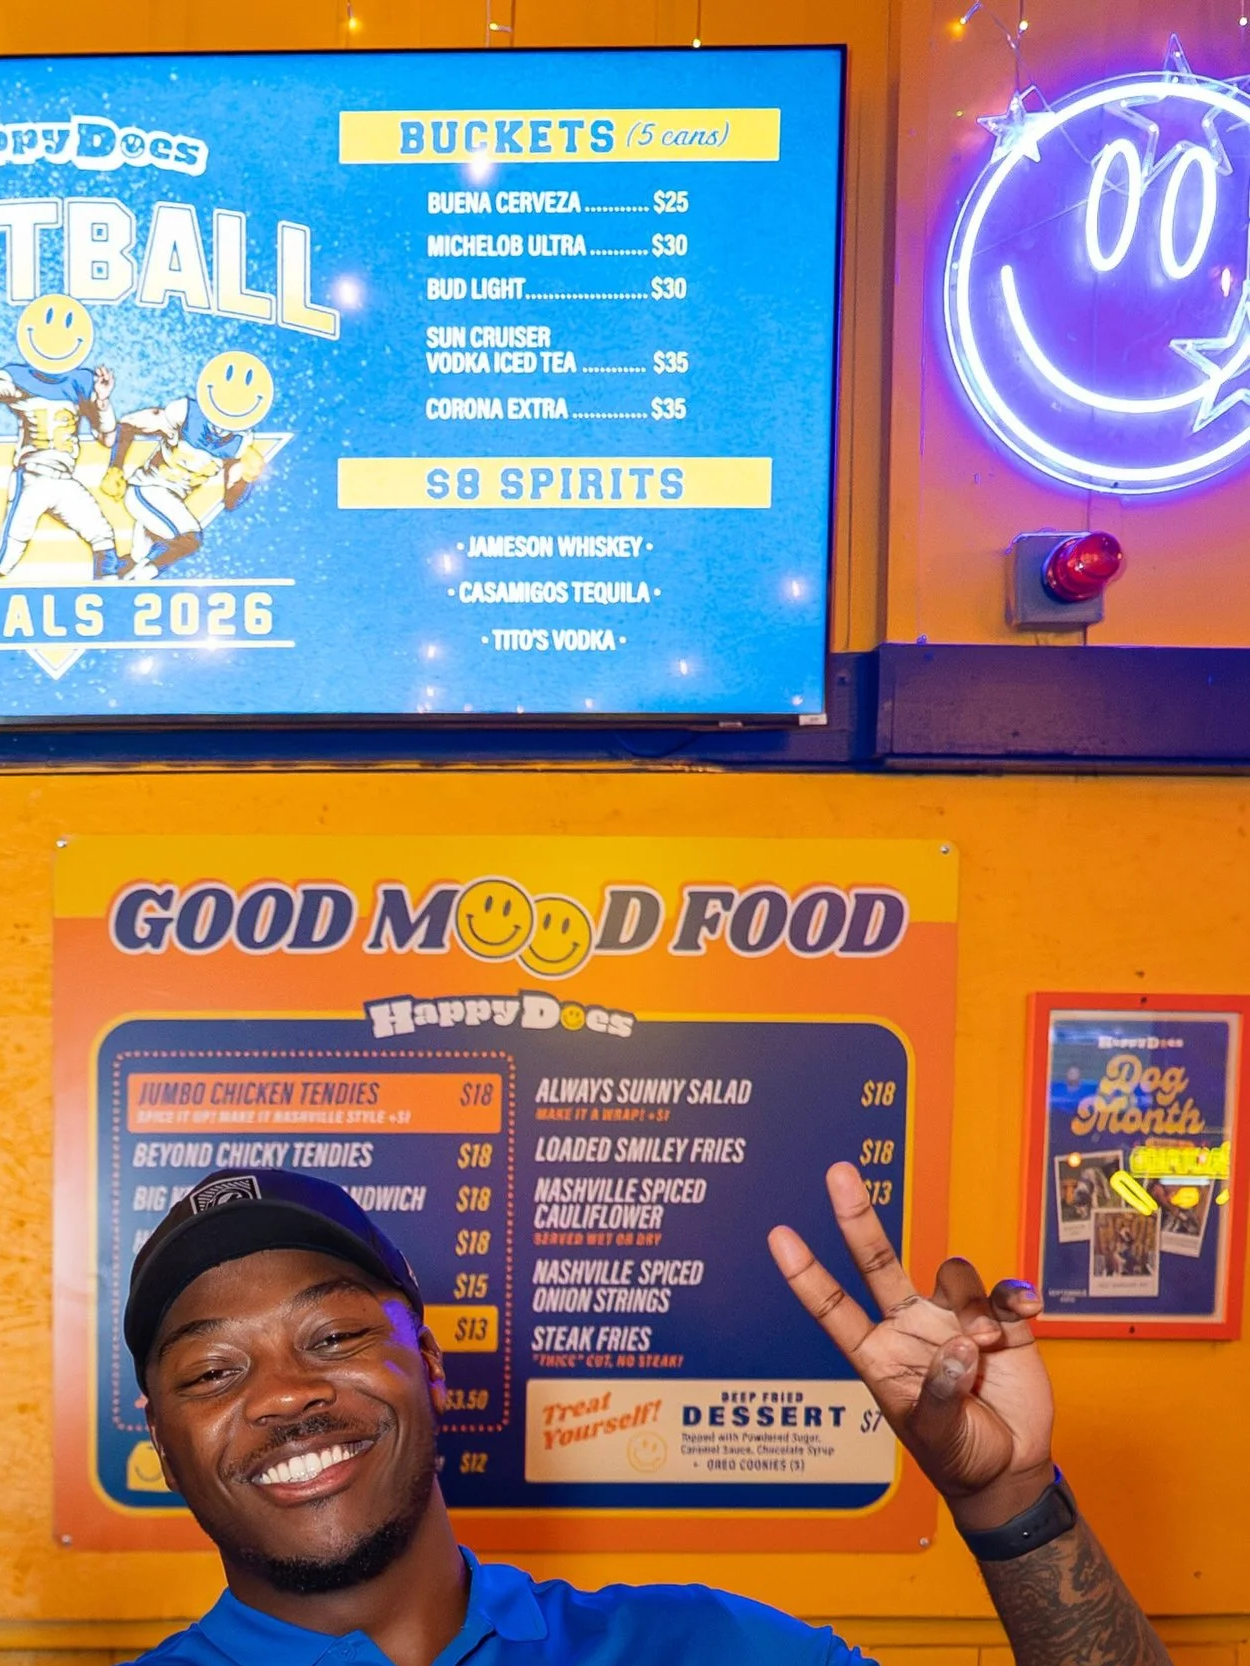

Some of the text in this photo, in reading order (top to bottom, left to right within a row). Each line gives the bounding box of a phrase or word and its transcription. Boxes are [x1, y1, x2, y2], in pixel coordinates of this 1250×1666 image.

[399, 119, 731, 155] BUCKETS (5 cans)
[427, 190, 689, 215] BUENA CERVEZA $25
[427, 233, 688, 258] MICHELOB ULTRA $30
[427, 277, 687, 301] BUD LIGHT $30
[426, 326, 551, 349] SUN CRUISER
[426, 351, 689, 375] VODKA ICED TEA $35
[425, 397, 687, 421] CORONA EXTRA $35
[500, 467, 686, 500] SPIRITS
[466, 535, 644, 559] JAMESON WHISKEY
[458, 581, 651, 604] CASAMIGOS TEQUILA
[133, 591, 274, 636] 2026
[491, 628, 616, 652] TITO'S VODKA
[114, 886, 353, 954] GOOD
[673, 887, 907, 957] FOOD
[1100, 1054, 1189, 1103] Dog
[139, 1081, 493, 1107] JUMBO CHICKEN TENDIES $18
[535, 1078, 897, 1107] ALWAYS SUNNY SALAD $18
[346, 1110, 384, 1124] STYLE
[1071, 1096, 1205, 1136] Month
[133, 1143, 492, 1169] BEYOND CHICKY TENDIES $18
[535, 1137, 895, 1165] LOADED SMILEY FRIES $18
[133, 1186, 167, 1212] BIG
[351, 1186, 426, 1212] NDWICH
[455, 1186, 491, 1213] $18
[534, 1178, 637, 1203] NASHVILLE
[640, 1178, 707, 1204] SPICED
[534, 1204, 664, 1229] CAULIFLOWER
[454, 1229, 490, 1256] $18
[533, 1260, 705, 1285] NASHVILLE SPICED
[453, 1273, 489, 1299] $15
[532, 1288, 671, 1313] ONION STRINGS
[454, 1317, 488, 1342] $13
[531, 1326, 652, 1352] STEAK FRIES
[616, 1354, 636, 1368] NO
[543, 1392, 612, 1426] Treat
[762, 1392, 804, 1403] FRIED
[543, 1399, 662, 1450] Yourself!
[682, 1406, 847, 1427] DESSERT
[739, 1459, 787, 1471] COOKIES
